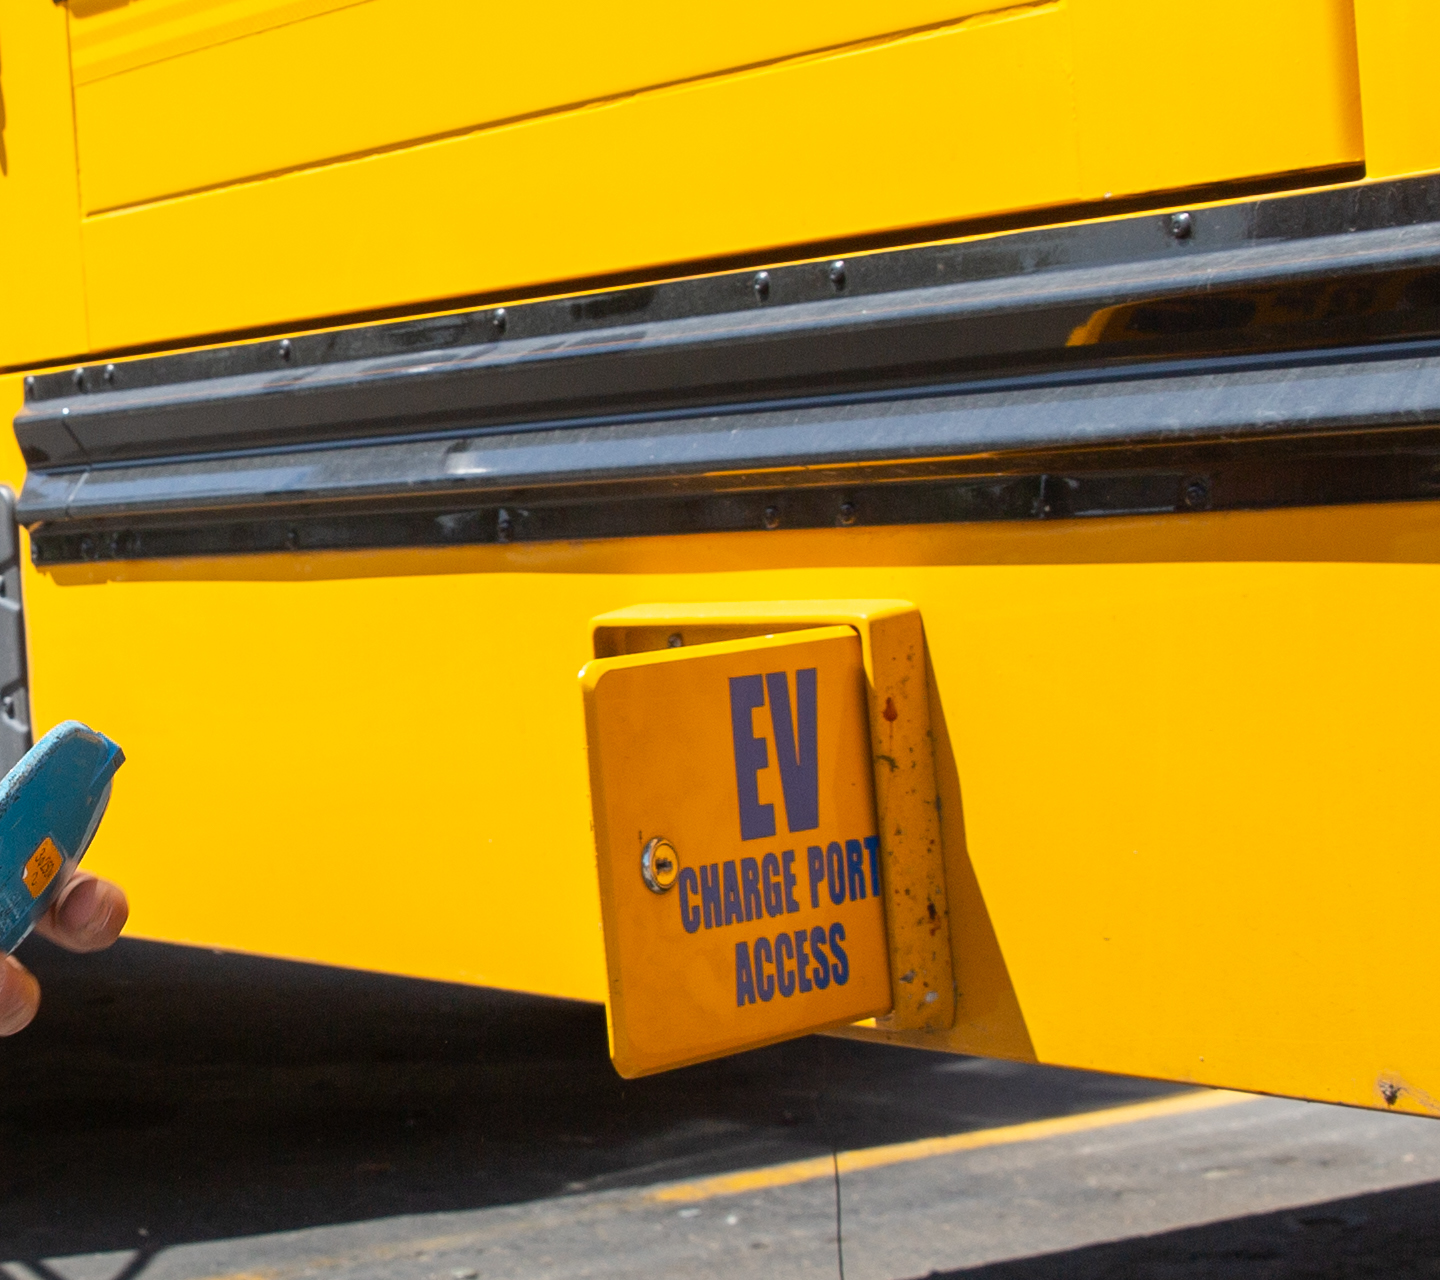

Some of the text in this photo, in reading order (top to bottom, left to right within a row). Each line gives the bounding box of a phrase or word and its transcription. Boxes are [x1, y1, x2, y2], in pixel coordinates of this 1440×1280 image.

[728, 667, 820, 842] EV
[678, 835, 881, 934] CHARGE PORT
[734, 922, 850, 1007] ACCESS
